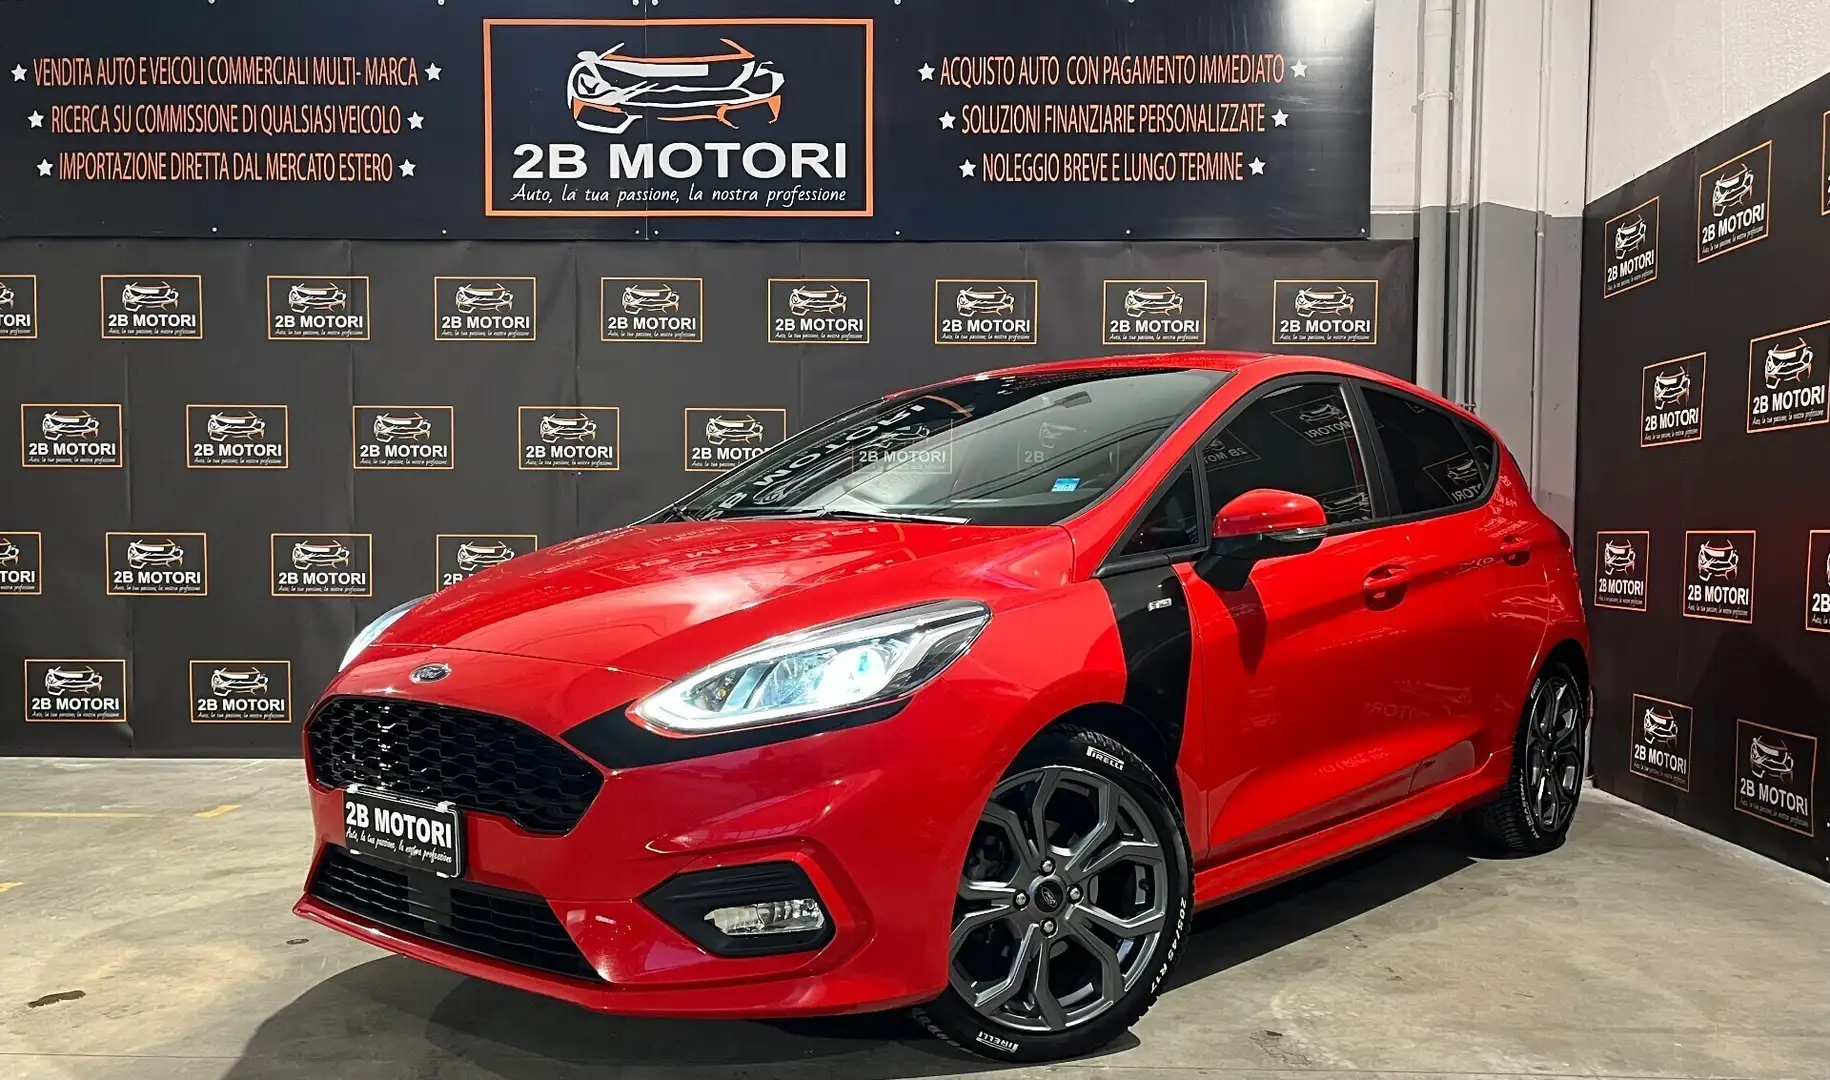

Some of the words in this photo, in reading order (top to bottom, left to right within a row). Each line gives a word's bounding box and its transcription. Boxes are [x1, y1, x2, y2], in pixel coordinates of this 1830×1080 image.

[34, 58, 93, 86] VENDITA
[97, 57, 135, 85] AUTO
[140, 57, 147, 84] E
[150, 56, 203, 84] VEICOLI
[208, 56, 308, 84] COMMERCIALI
[314, 57, 361, 85] MULTI-
[366, 57, 418, 85] MARCA
[940, 56, 1014, 87] ACQUISTO
[1019, 56, 1059, 85] AUTO
[1067, 56, 1098, 85] CON
[1104, 55, 1195, 84] PAGAMENTO
[1200, 52, 1285, 85] IMMEDIATO
[52, 105, 110, 133] RICERCA
[114, 105, 131, 132] SU
[136, 104, 238, 133] COMMISSIONE
[243, 105, 256, 132] DI
[261, 105, 335, 136] QUALSIASI
[339, 105, 400, 133] VEICOLO
[962, 105, 1040, 133] SOLUZIONI
[1045, 105, 1134, 133] FINANZIARIE
[1140, 104, 1265, 132] PERSONALIZZATE
[60, 152, 166, 180] IMPORTAZIONE
[171, 152, 229, 180] DIRETTA
[234, 153, 262, 180] DAL
[267, 153, 335, 181] MERCATO
[340, 153, 392, 181] ESTERO
[513, 144, 587, 178] 2B
[610, 142, 845, 178] MOTORI
[984, 153, 1059, 181] NOLEGGIO
[1064, 153, 1108, 181] BREVE
[1113, 153, 1120, 181] E
[1125, 153, 1176, 181] LUNGO
[1179, 152, 1243, 180] TERMINE
[510, 184, 552, 203] Auto,
[562, 184, 578, 200] la
[585, 189, 608, 201] tua
[617, 188, 679, 207] passione,
[689, 183, 702, 200] la
[712, 189, 758, 200] nostra
[766, 185, 846, 207] professione
[1702, 223, 1716, 245] 2B
[1718, 202, 1765, 237] MOTORI
[1607, 265, 1618, 283] 2B
[1620, 249, 1654, 278] MOTORI
[109, 314, 128, 326] 2B
[133, 314, 195, 326] MOTORI
[275, 315, 295, 327] 2B
[301, 316, 362, 328] MOTORI
[442, 316, 461, 328] 2B
[467, 316, 529, 328] MOTORI
[608, 317, 628, 329] 2B
[634, 317, 695, 330] MOTORI
[776, 319, 795, 331] 2B
[801, 318, 863, 331] MOTORI
[942, 320, 962, 332] 2B
[967, 319, 1030, 332] MOTORI
[1110, 320, 1130, 332] 2B
[1136, 320, 1199, 332] MOTORI
[1280, 320, 1300, 332] 2B
[1306, 320, 1370, 332] MOTORI
[1752, 395, 1769, 414] 2B
[1772, 385, 1825, 411] MOTORI
[1645, 415, 1658, 431] 2B
[1660, 407, 1699, 430] MOTORI
[29, 443, 49, 455] 2B
[54, 443, 115, 455] MOTORI
[194, 444, 214, 456] 2B
[219, 444, 281, 456] MOTORI
[360, 445, 380, 457] 2B
[385, 445, 447, 457] MOTORI
[526, 446, 545, 458] 2B
[551, 446, 612, 458] MOTORI
[692, 448, 712, 459] 2B
[717, 448, 772, 460] MOTO
[859, 451, 878, 462] 2B
[884, 451, 946, 462] MOTORI
[1024, 451, 1044, 463] 2B
[114, 571, 133, 583] 2B
[138, 572, 200, 583] MOTORI
[279, 572, 298, 584] 2B
[303, 573, 365, 584] MOTORI
[1608, 579, 1644, 596] MOTORI
[1687, 585, 1702, 601] 2B
[1704, 585, 1749, 606] MOTORI
[32, 698, 51, 710] 2B
[56, 698, 119, 710] MOTORI
[198, 699, 217, 711] 2B
[223, 699, 284, 711] MOTORI
[1086, 746, 1124, 771] PIRELLI
[1634, 744, 1646, 761] 2B
[1648, 748, 1687, 775] MOTORI
[1740, 777, 1755, 797] 2B
[1758, 782, 1808, 817] MOTORI
[346, 801, 369, 828] 2B
[374, 807, 452, 849] MOTORI
